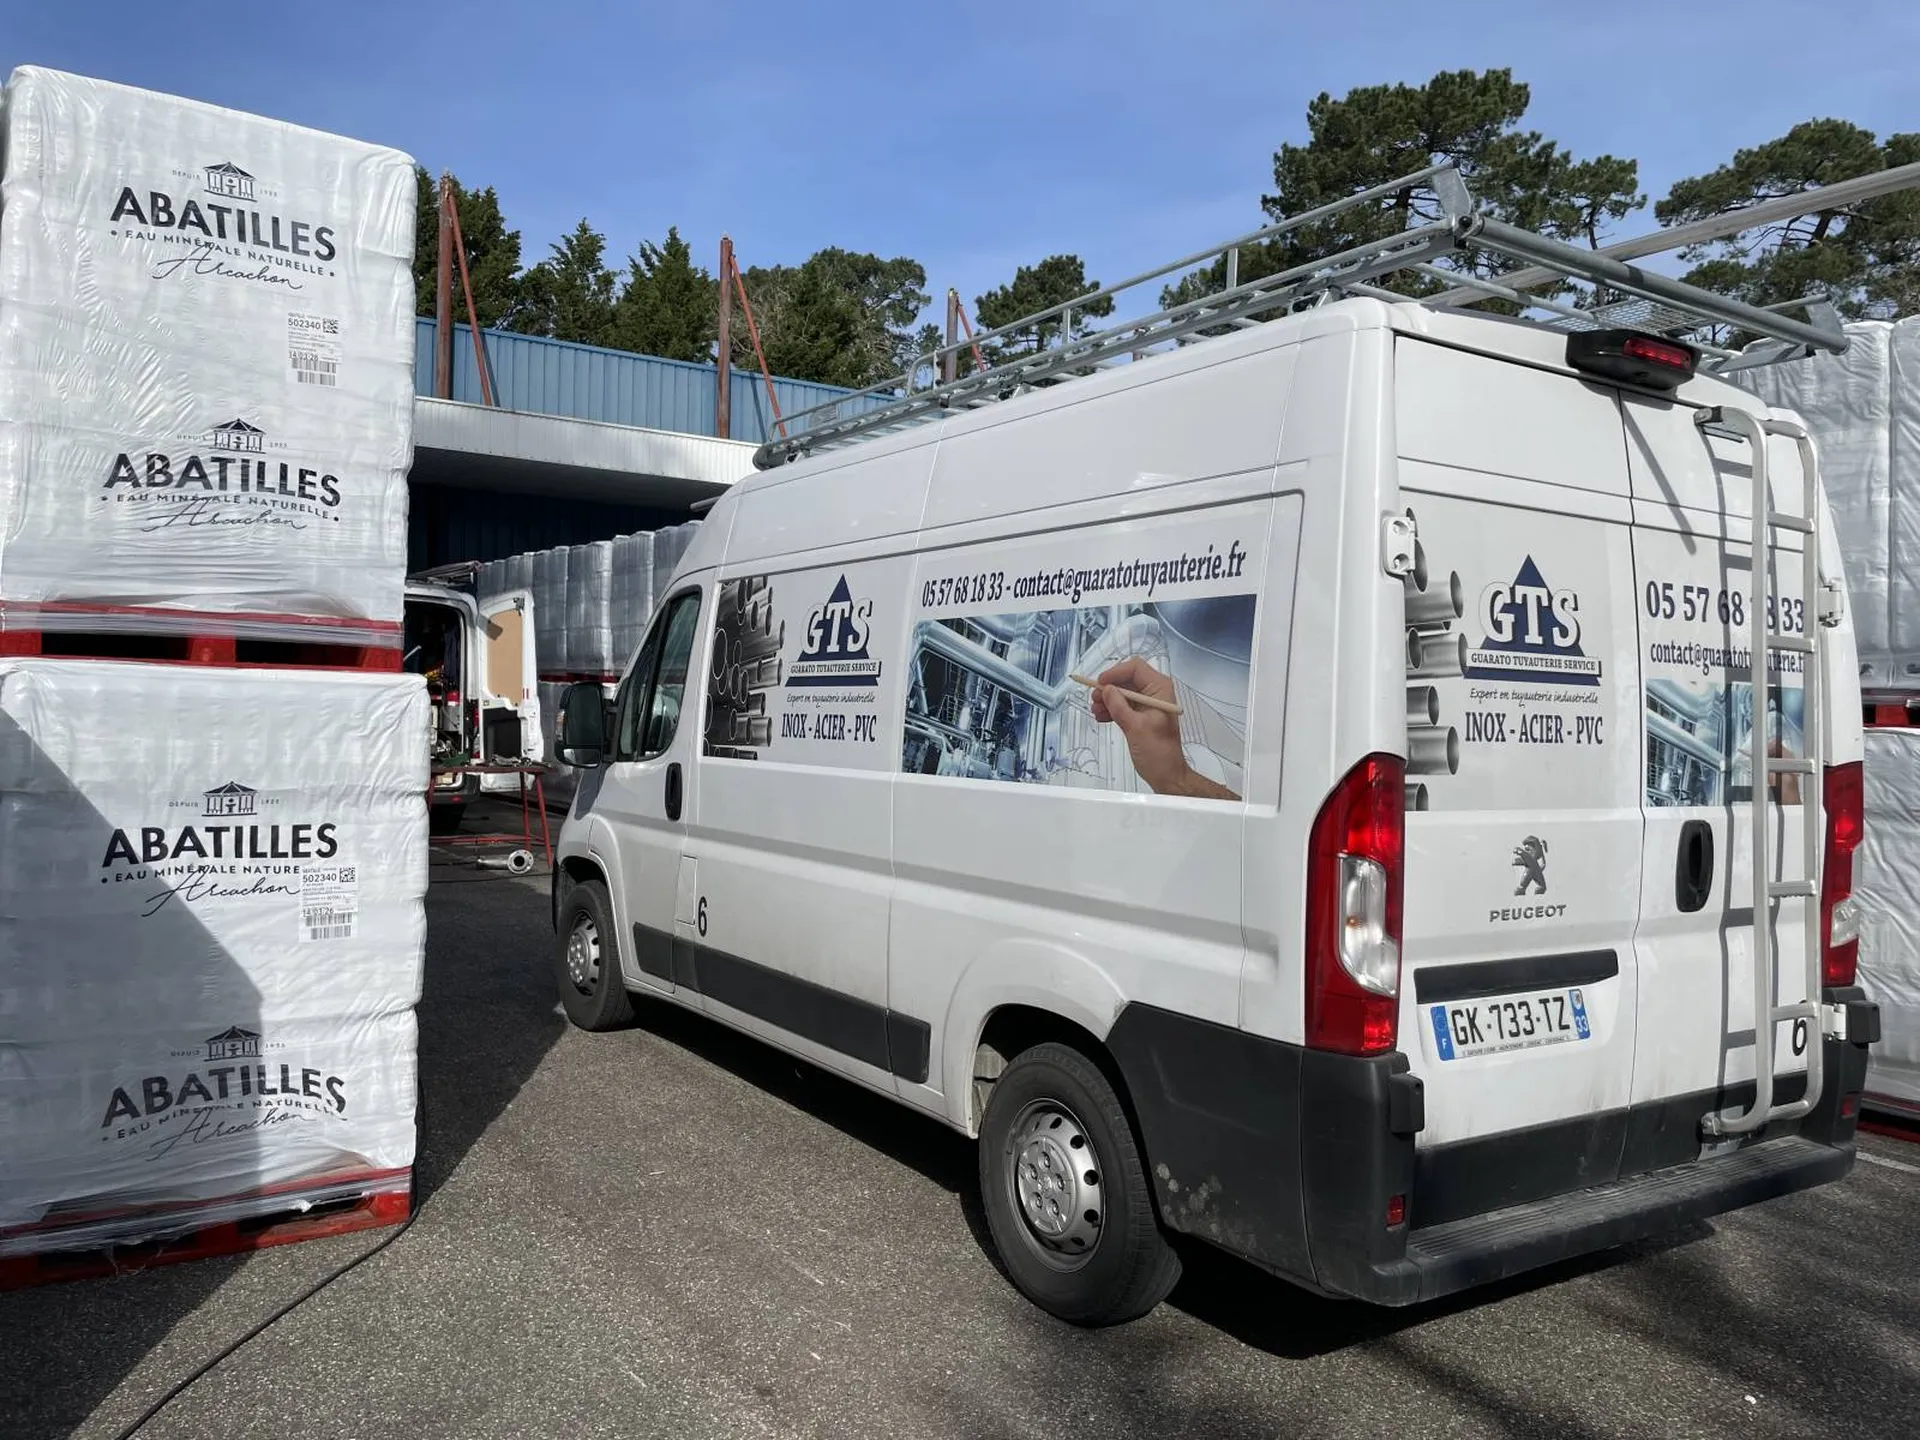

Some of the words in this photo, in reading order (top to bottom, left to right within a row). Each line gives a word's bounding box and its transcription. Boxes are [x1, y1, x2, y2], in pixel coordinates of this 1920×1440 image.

[110, 187, 336, 261] ABATILLES
[125, 230, 156, 241] EAU
[248, 251, 324, 276] NATURELLE
[288, 318, 320, 329] 502340
[103, 453, 341, 507] ABATILLES
[117, 493, 149, 502] EAU
[249, 496, 328, 518] NATURELLE
[922, 580, 936, 607] 05
[937, 578, 953, 606] 57
[954, 575, 969, 604] 68
[971, 573, 987, 603] 18
[987, 571, 1004, 602] 33
[1013, 540, 1246, 604] contact@guaratotuyauterie.fr
[1478, 581, 1579, 648] GTS
[1646, 580, 1675, 619] 05
[1683, 585, 1710, 623] 57
[1717, 589, 1744, 626] 68
[1781, 597, 1804, 633] 33
[802, 597, 873, 655] GTS
[851, 661, 877, 672] SERVICE
[1471, 652, 1511, 666] GUARATO
[1513, 655, 1562, 669] TUYAUTERIE
[1564, 659, 1596, 671] SERVICE
[1470, 687, 1498, 704] Expert
[1512, 689, 1553, 708] tuyauterie
[1554, 690, 1598, 704] industrielle
[781, 713, 807, 738] INOX
[814, 712, 845, 740] ACIER
[854, 714, 877, 742] PVC
[1465, 712, 1506, 742] INOX
[1519, 713, 1564, 744] ACIER
[1576, 716, 1603, 745] PVC
[102, 822, 338, 868] ABATILLES
[115, 870, 147, 882] EAU
[243, 865, 300, 874] NATURE
[302, 873, 337, 883] 502340
[141, 865, 300, 917] Arcachon
[698, 896, 707, 937] 6
[1489, 904, 1567, 922] PEUGEOT
[1575, 1015, 1588, 1032] 33
[1441, 1039, 1447, 1050] F
[102, 1064, 348, 1128] ABATILLES
[117, 1122, 150, 1139] EAU
